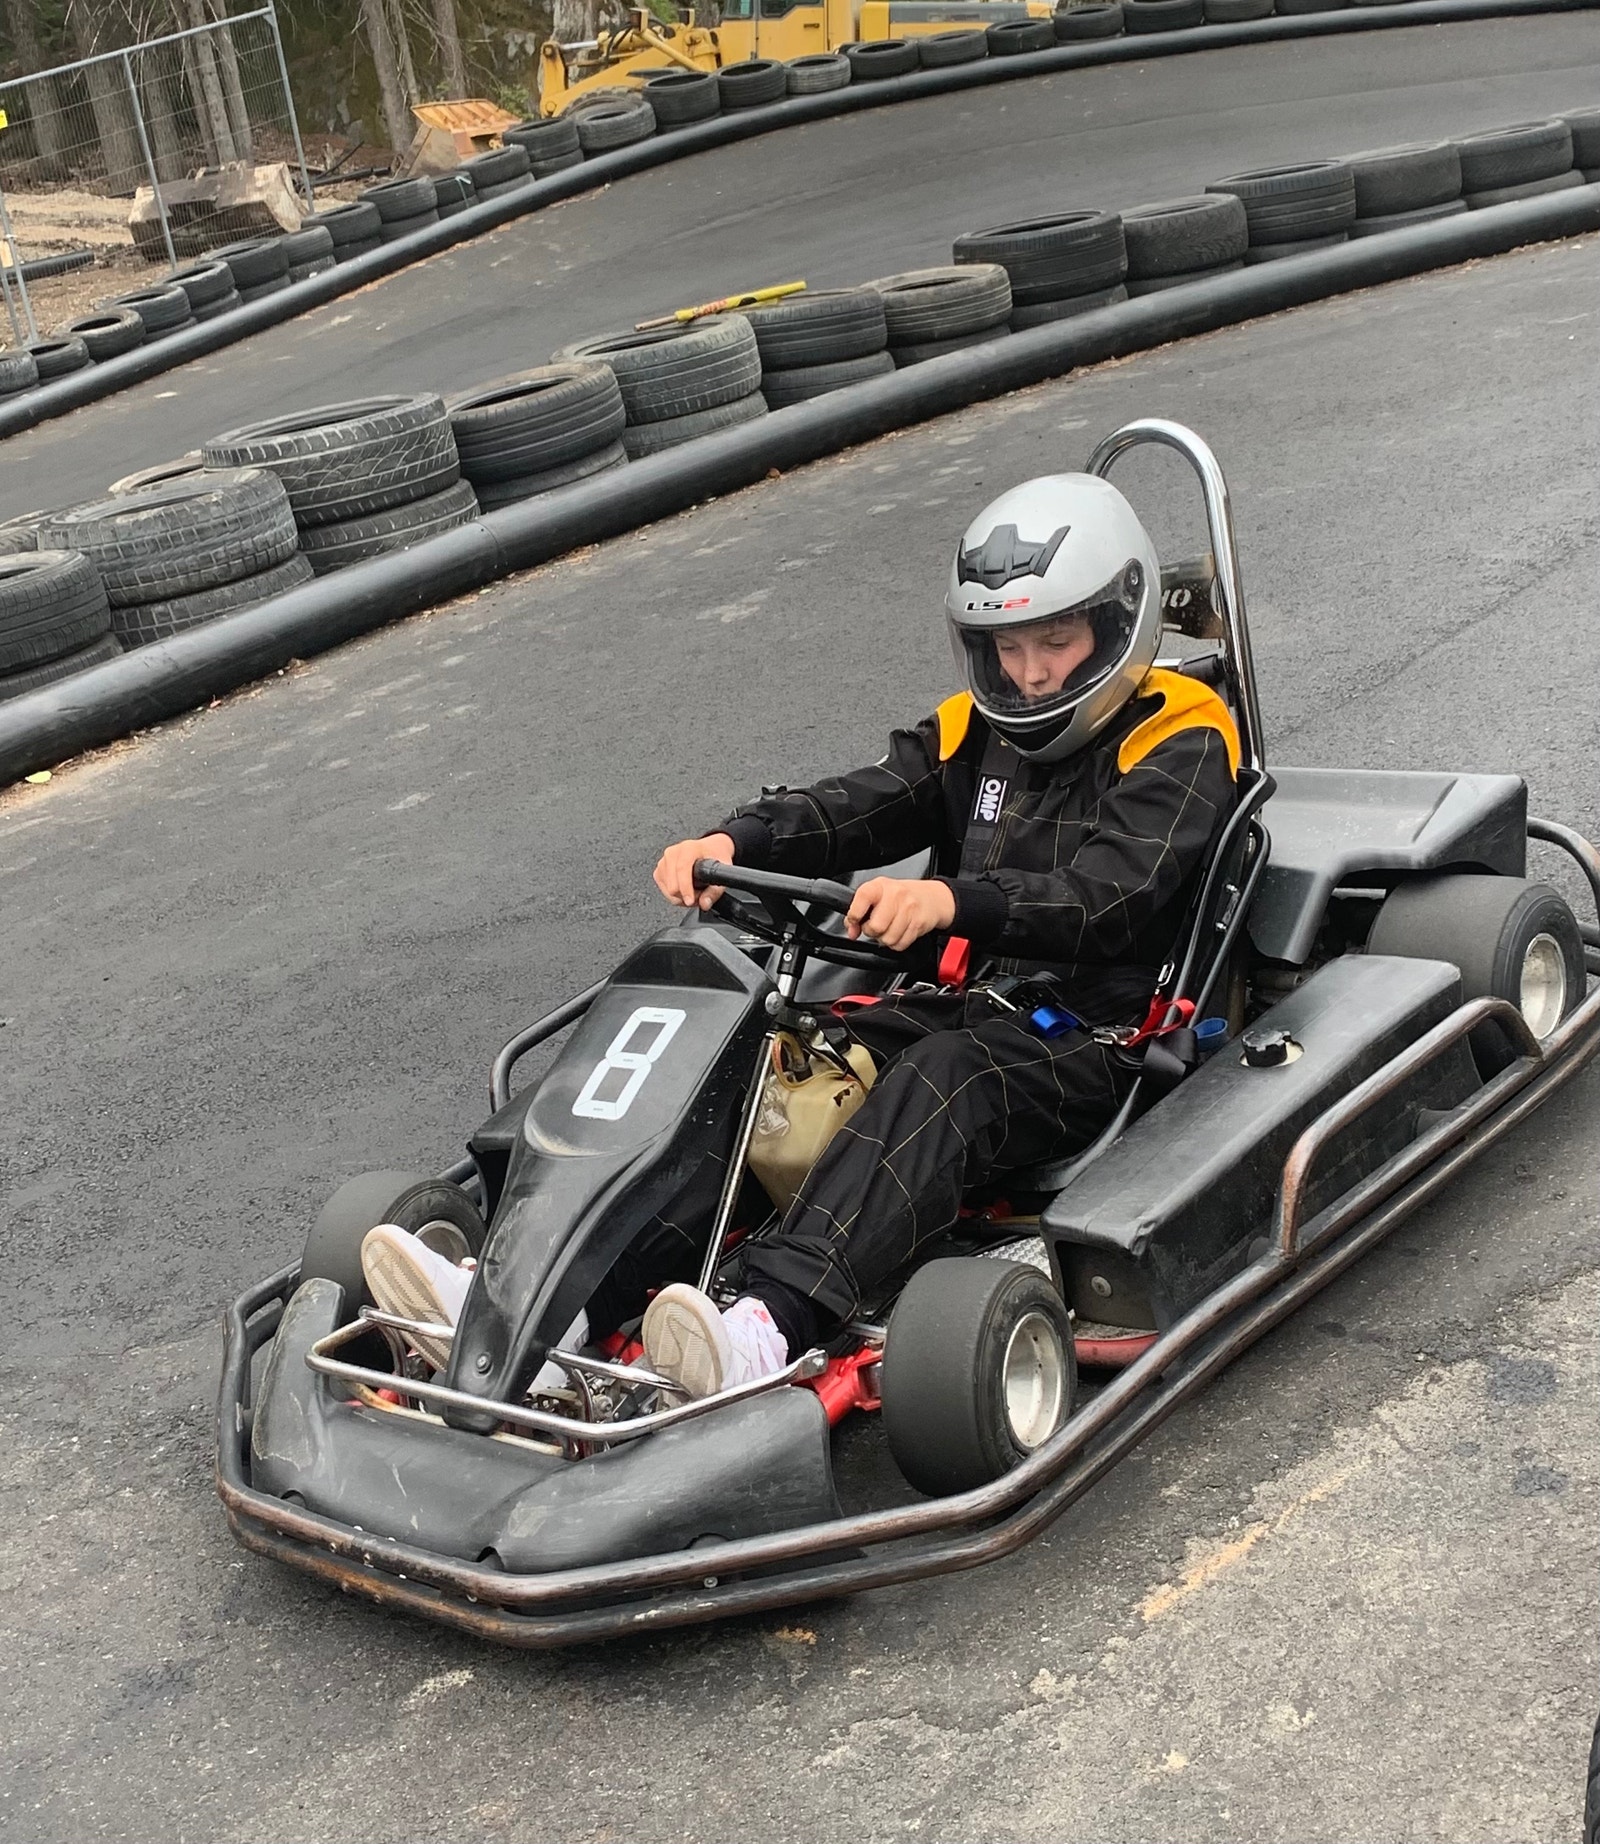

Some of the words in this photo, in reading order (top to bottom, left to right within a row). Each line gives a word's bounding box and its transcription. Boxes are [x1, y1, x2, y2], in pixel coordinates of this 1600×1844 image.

[966, 597, 1031, 612] LS2
[980, 779, 1002, 821] OMP
[572, 1006, 687, 1120] 8
